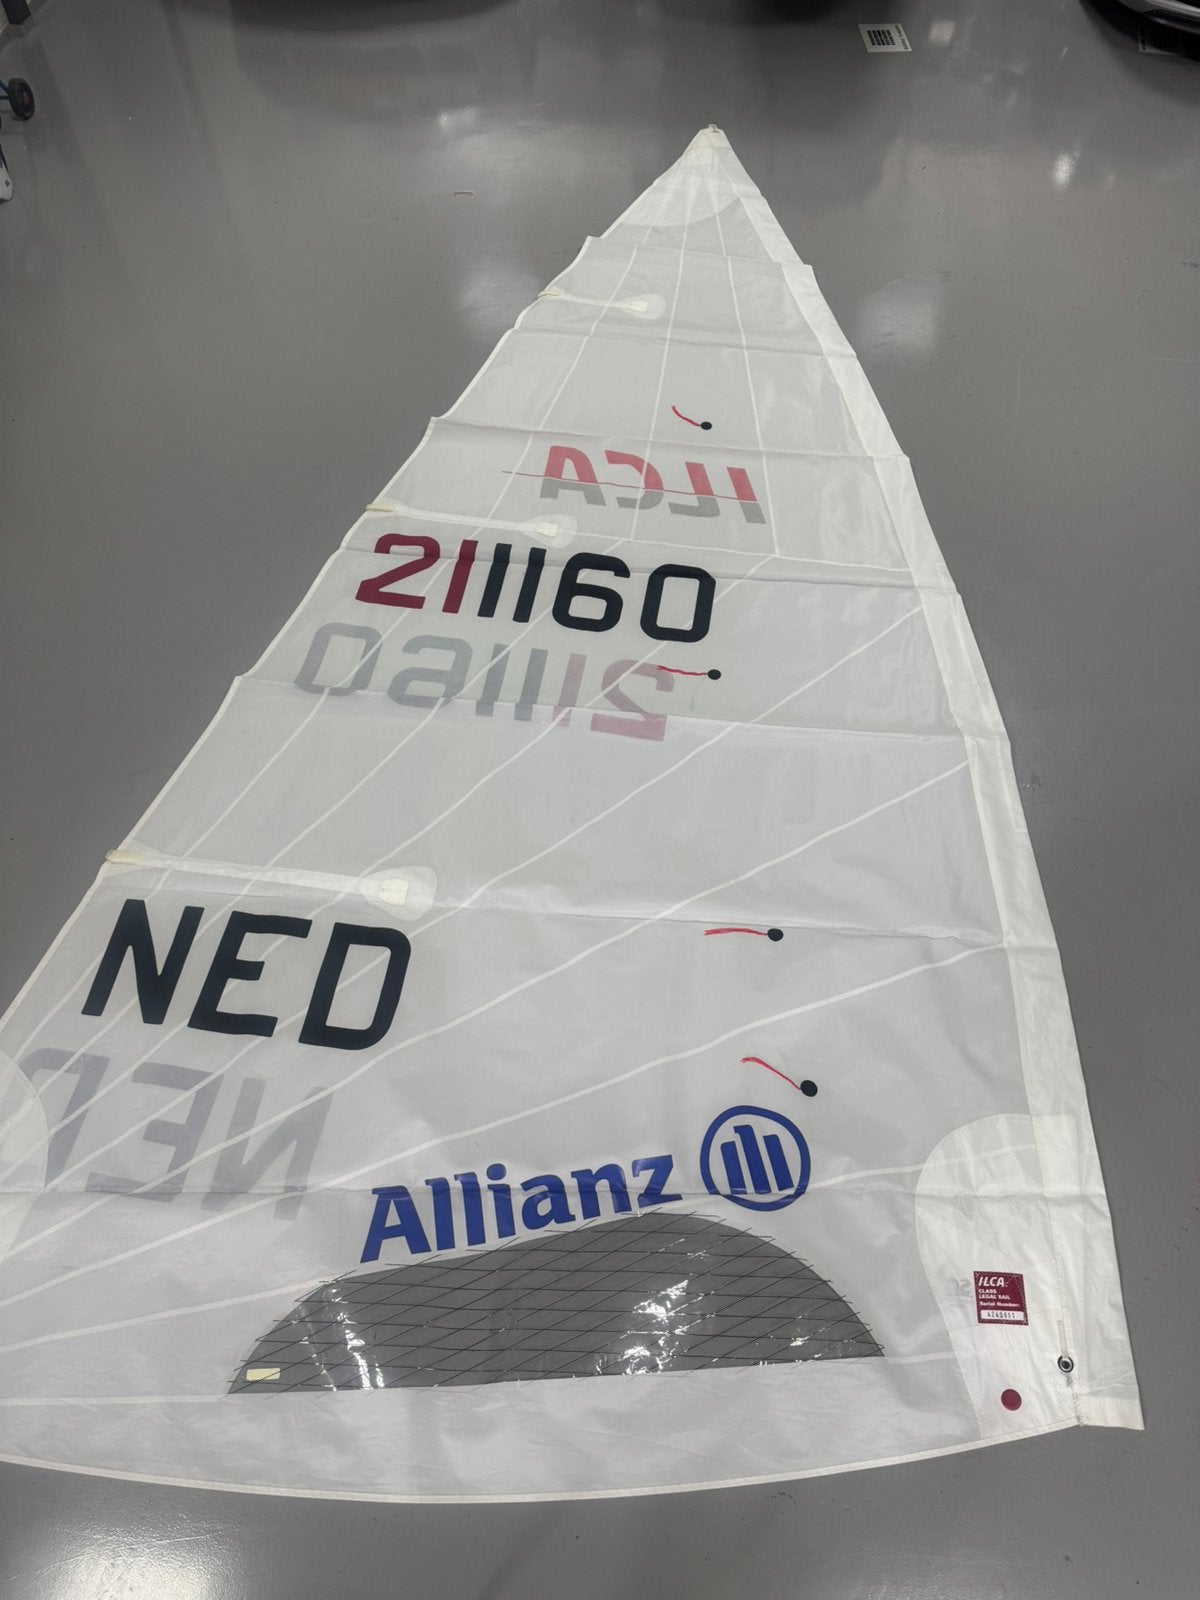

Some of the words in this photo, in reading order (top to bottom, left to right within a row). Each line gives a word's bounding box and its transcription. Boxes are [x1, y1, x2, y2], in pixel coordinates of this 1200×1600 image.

[355, 533, 716, 643] 211160
[81, 899, 411, 1050] NED
[360, 1154, 683, 1263] Allianz
